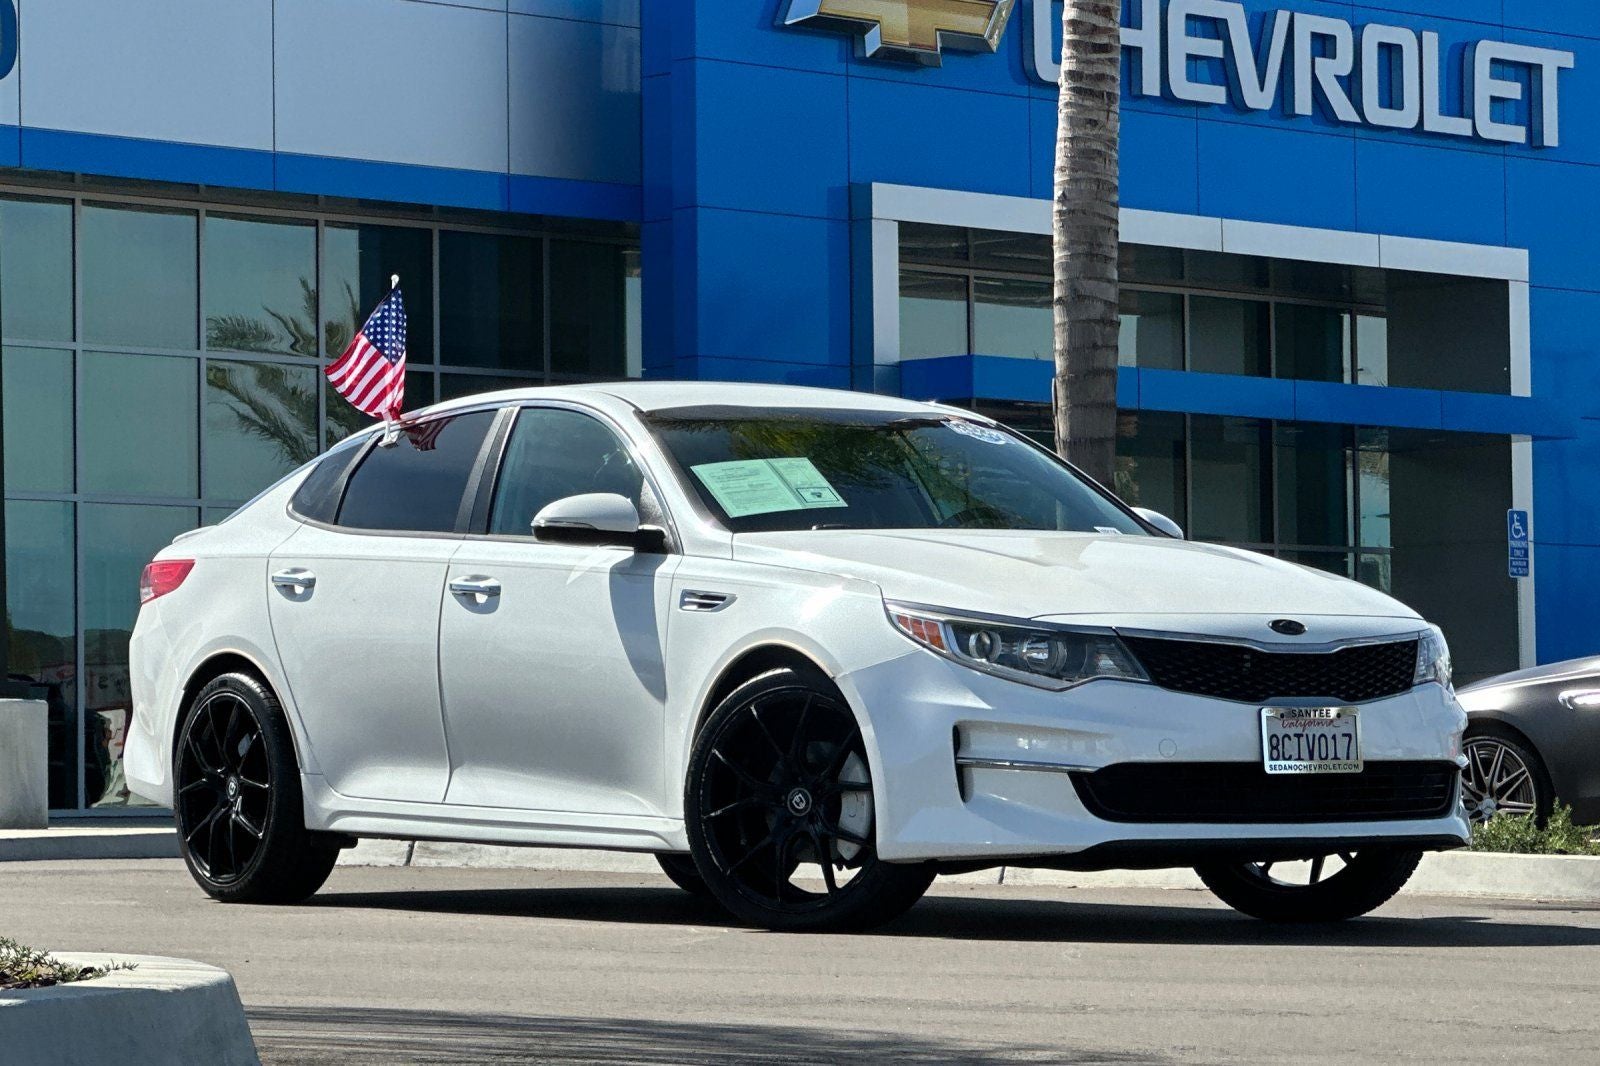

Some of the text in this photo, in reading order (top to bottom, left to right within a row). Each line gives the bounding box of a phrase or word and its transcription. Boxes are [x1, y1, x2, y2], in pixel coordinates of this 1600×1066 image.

[1291, 708, 1331, 718] SANTEE
[1281, 719, 1337, 732] California
[1269, 733, 1353, 761] 8CIV017
[1269, 763, 1360, 772] SEDANOCHEVROLET.COM
